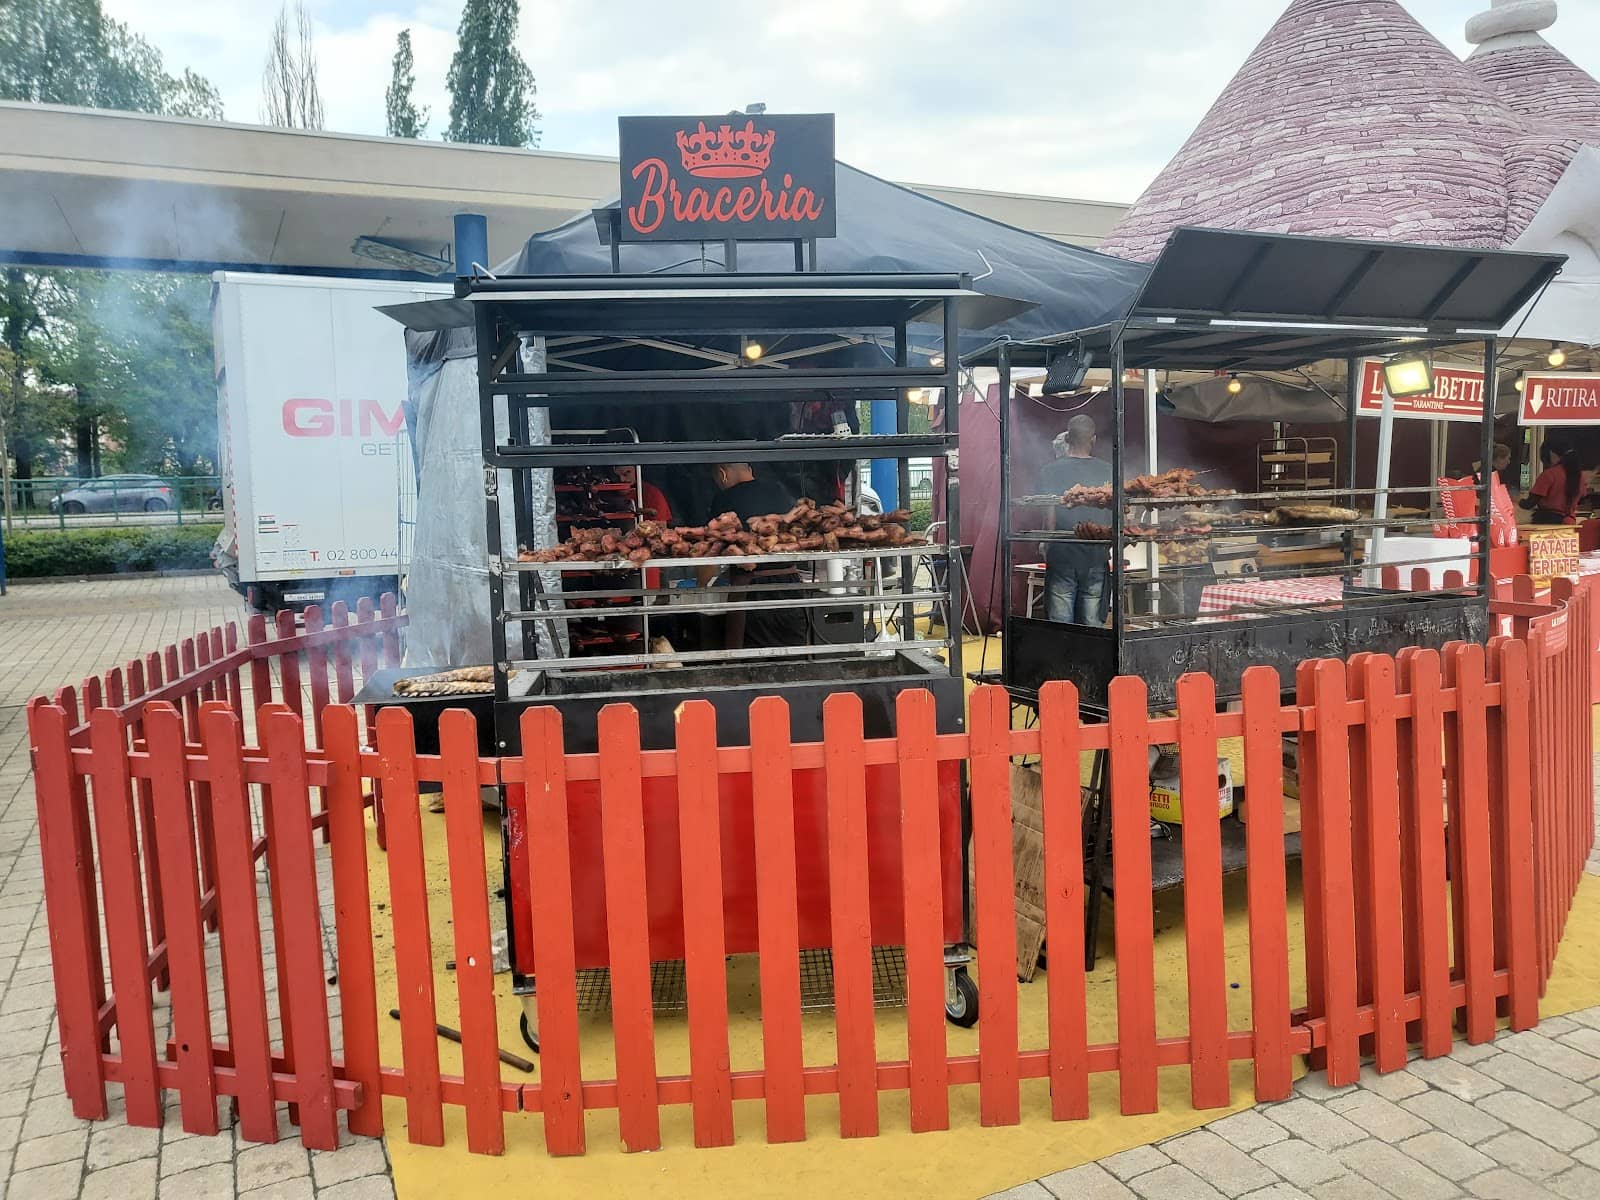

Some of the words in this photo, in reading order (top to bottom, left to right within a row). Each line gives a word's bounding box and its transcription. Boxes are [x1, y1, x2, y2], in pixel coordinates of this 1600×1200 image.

[629, 158, 824, 234] Braceria
[1413, 400, 1444, 409] TARANTINE
[1546, 387, 1598, 408] RITIRA
[327, 550, 345, 561] 02
[350, 549, 377, 560] 800
[1530, 538, 1577, 556] PATATE
[1533, 557, 1577, 576] FRITTE
